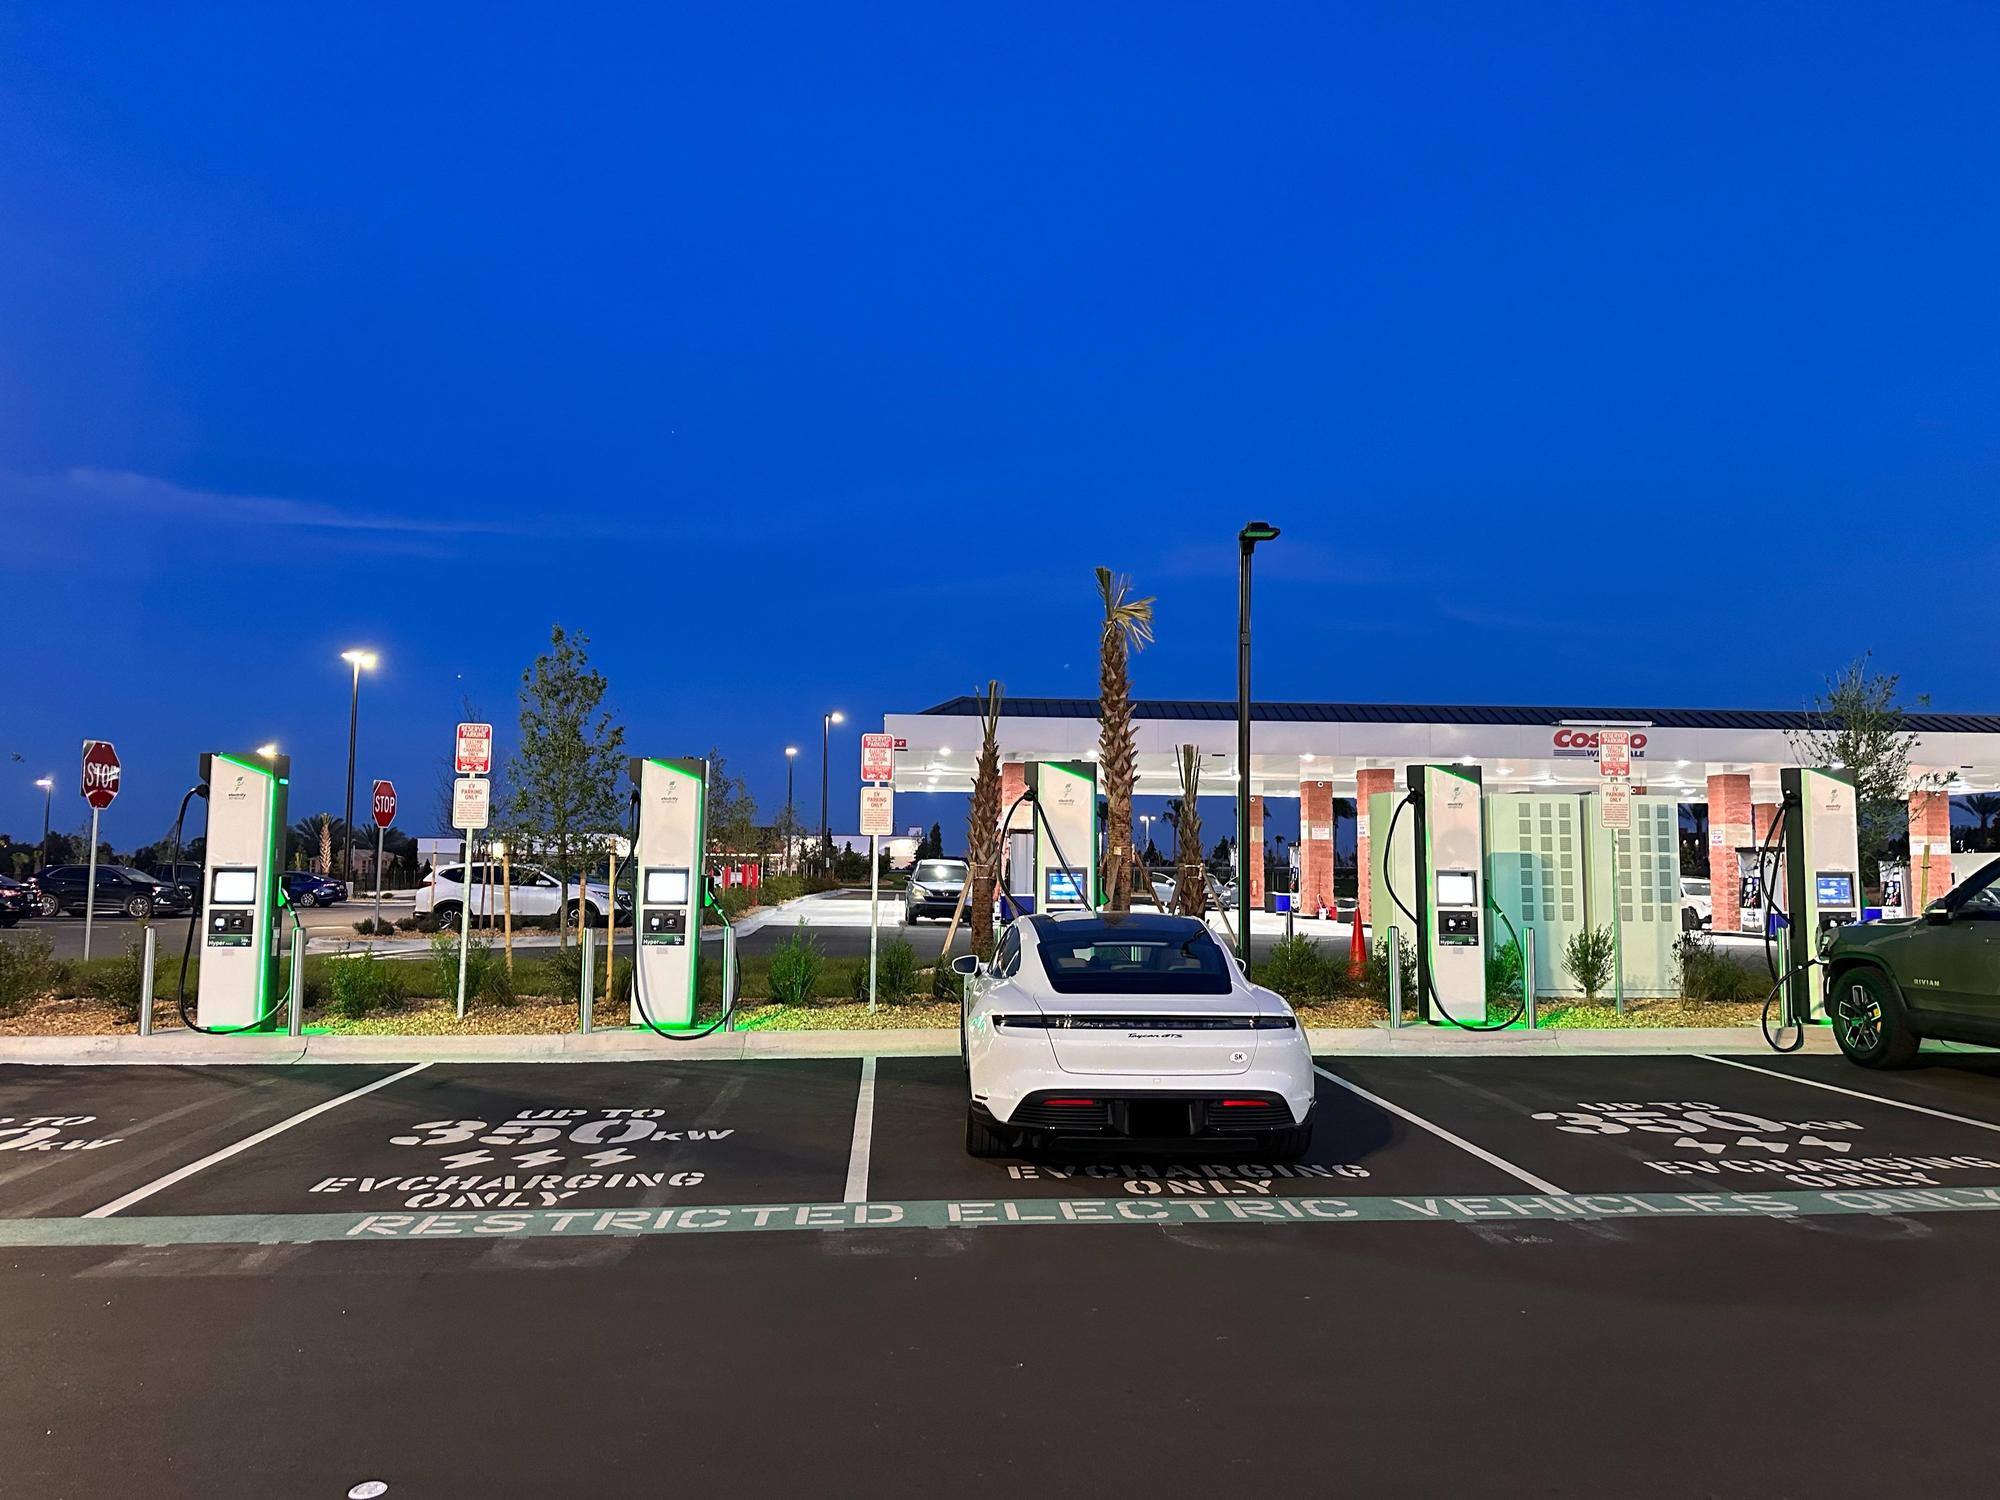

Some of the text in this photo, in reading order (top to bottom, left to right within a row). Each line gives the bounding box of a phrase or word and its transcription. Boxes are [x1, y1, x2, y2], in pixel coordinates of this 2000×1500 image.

[86, 762, 120, 788] STOP
[375, 796, 395, 813] STOP
[1914, 978, 1940, 986] RIVIAN
[516, 1108, 666, 1119] UP TO
[1577, 1102, 1721, 1111] UP TO
[22, 1116, 97, 1126] TO
[1124, 1180, 1272, 1194] ONLY
[1785, 1172, 1941, 1188] ONLY
[404, 1191, 579, 1208] ONLY
[346, 1204, 904, 1236] RESTRICTED
[947, 1200, 1359, 1222] ELECTRIC
[1391, 1194, 1799, 1216] VEHICLES
